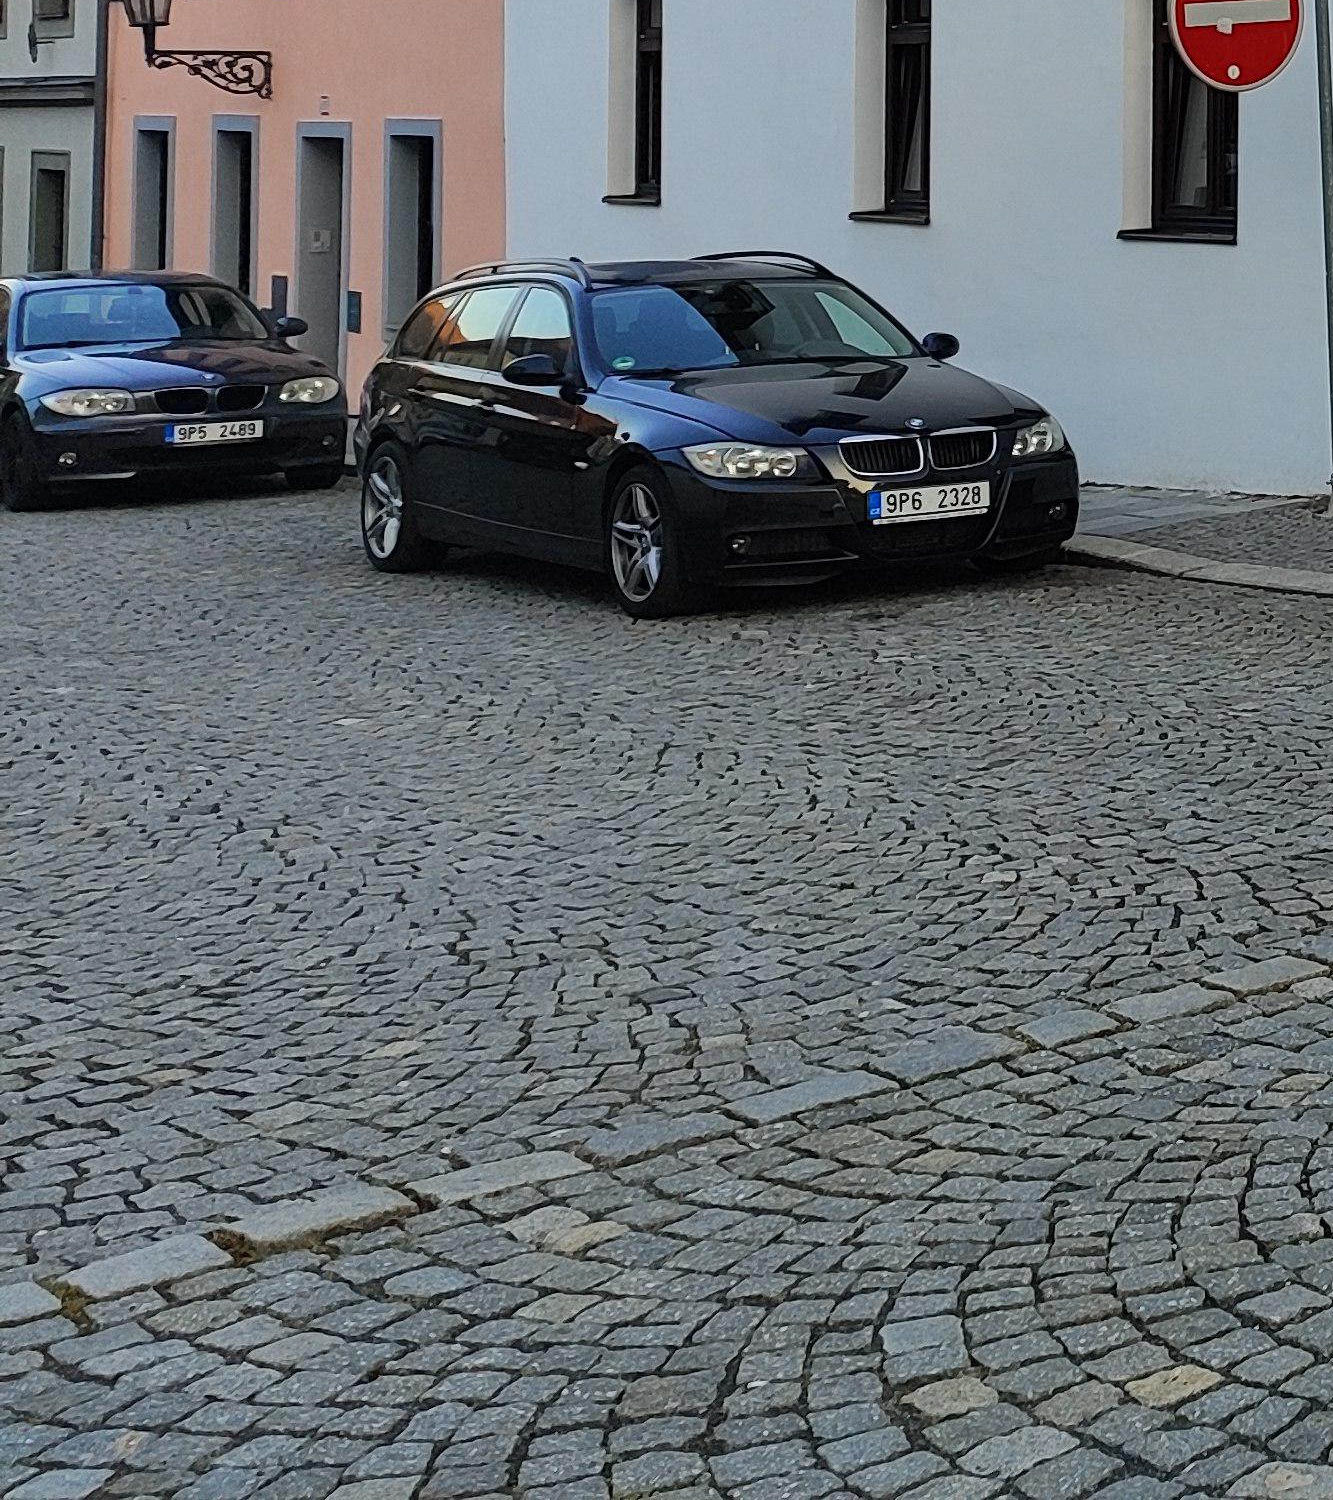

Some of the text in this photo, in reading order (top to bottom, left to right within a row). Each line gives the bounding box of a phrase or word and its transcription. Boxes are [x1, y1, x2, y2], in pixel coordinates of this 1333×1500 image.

[178, 423, 256, 440] 9P5 2489
[886, 492, 922, 514] 9P6
[938, 486, 982, 508] 2328
